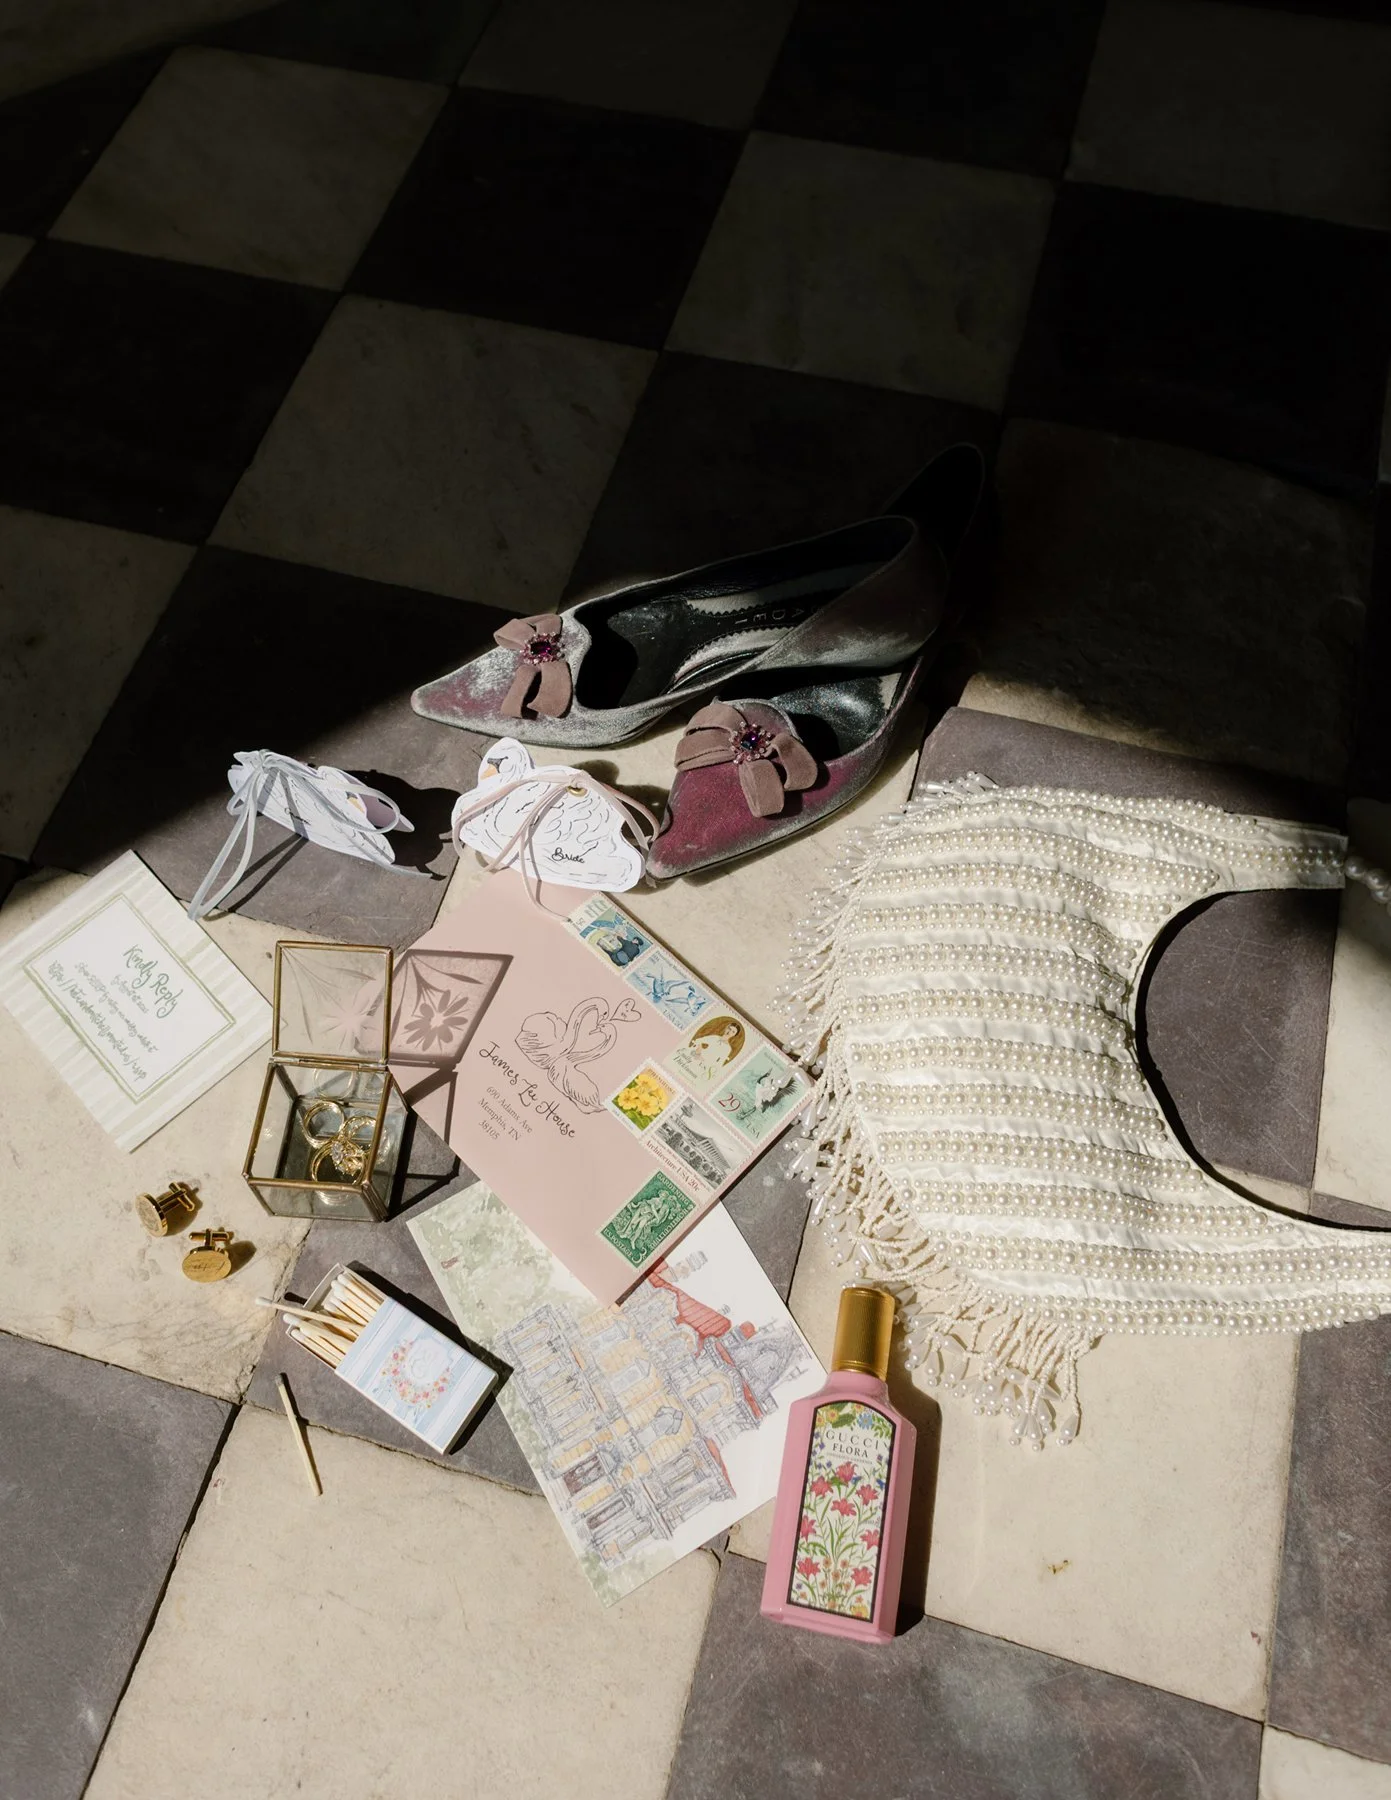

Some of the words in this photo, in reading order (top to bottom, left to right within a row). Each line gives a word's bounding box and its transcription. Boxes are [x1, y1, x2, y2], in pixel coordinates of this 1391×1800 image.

[551, 846, 586, 864] Bride
[123, 944, 158, 989] Kindly
[149, 973, 183, 1019] Reply
[478, 1040, 519, 1085] James
[535, 1100, 576, 1138] House
[718, 1092, 742, 1112] 29
[478, 1098, 507, 1131] Memphis,
[507, 1126, 522, 1141] TN
[486, 1086, 500, 1100] 690
[499, 1098, 521, 1121] Adams
[519, 1119, 533, 1134] Ave
[478, 1120, 500, 1141] 38105
[745, 1121, 760, 1139] USA
[646, 1140, 677, 1171] Architecture
[656, 1172, 689, 1205] GARDENING
[650, 1208, 690, 1248] HORTICULTURE
[826, 1429, 879, 1450] GUCCI
[832, 1442, 868, 1458] FLORA
